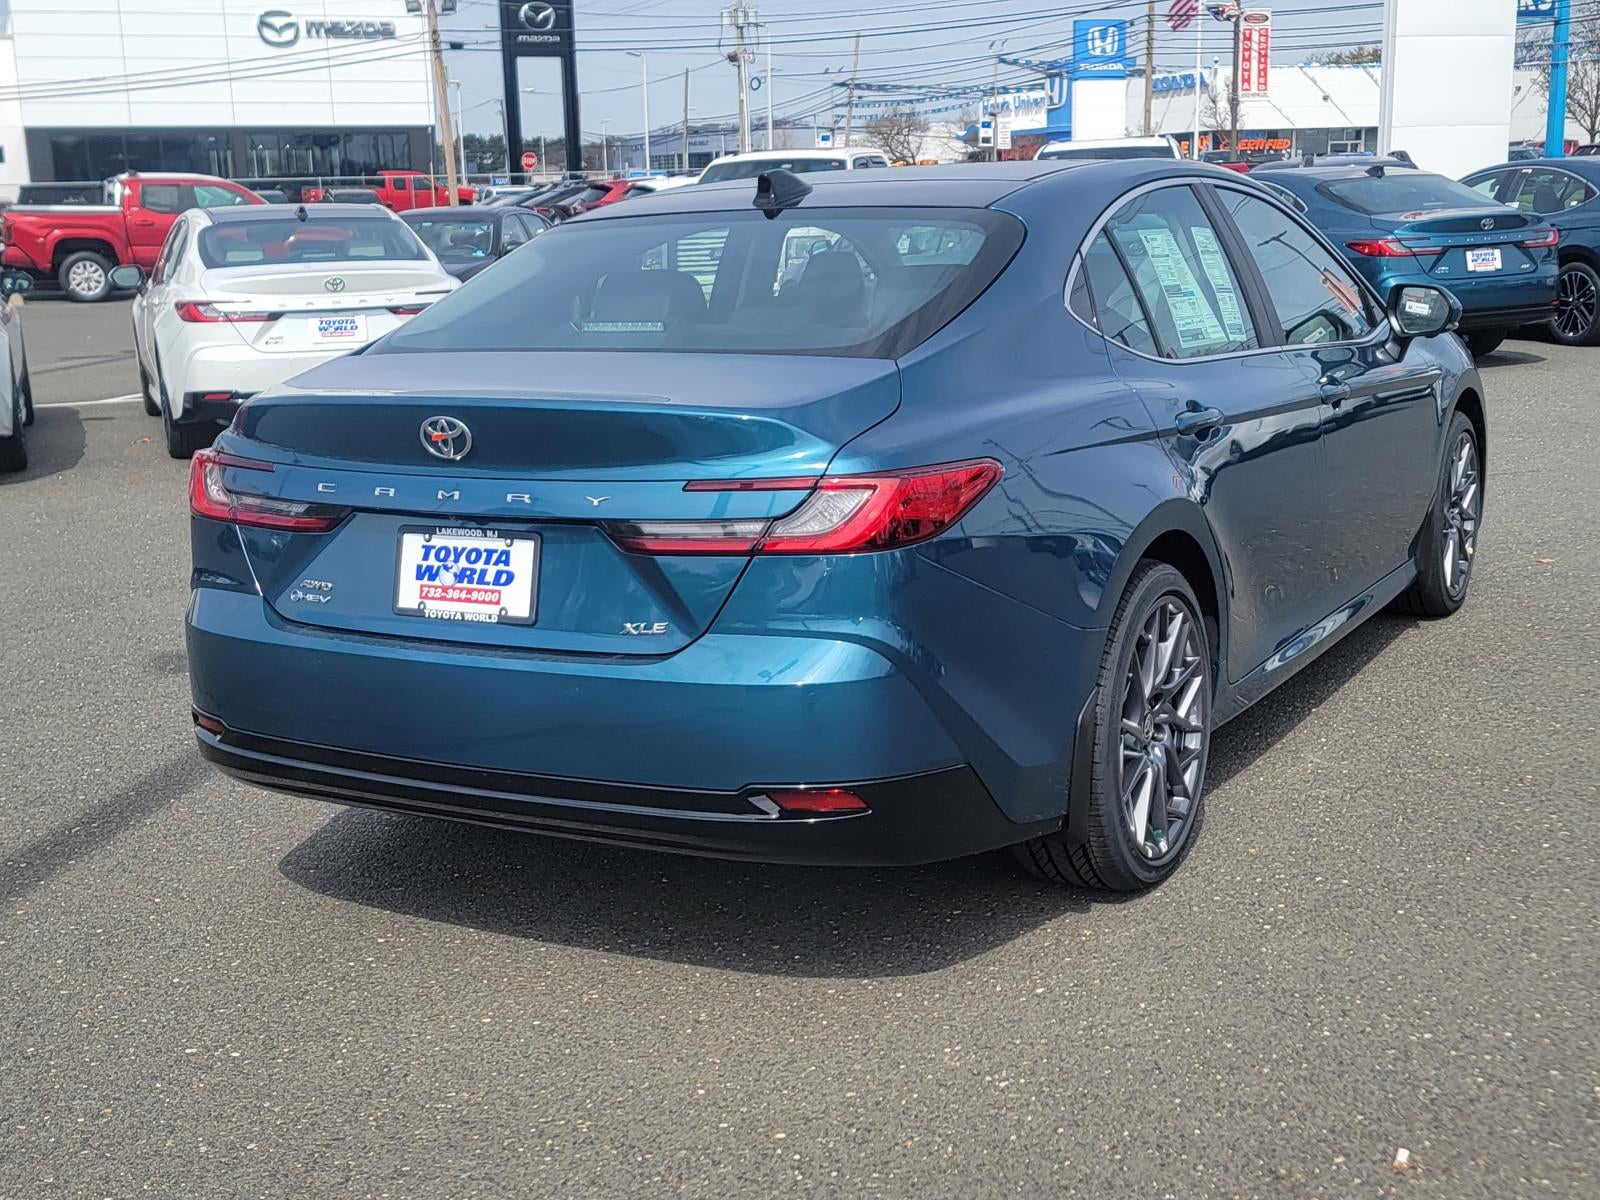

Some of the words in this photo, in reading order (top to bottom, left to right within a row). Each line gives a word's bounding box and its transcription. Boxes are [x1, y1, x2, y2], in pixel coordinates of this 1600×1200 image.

[518, 34, 561, 42] mazda
[1242, 29, 1252, 91] TOYOTA
[1258, 28, 1268, 91] CERTIFIED
[522, 156, 537, 164] STOP
[319, 318, 356, 326] TOYOTA
[317, 482, 611, 506] CAMRY
[486, 529, 498, 538] NJ
[421, 544, 511, 567] TOYOTA
[421, 587, 500, 602] 732-364-9000
[424, 609, 462, 621] TOYOTA
[463, 612, 498, 624] WORLD
[618, 622, 669, 635] XLE
